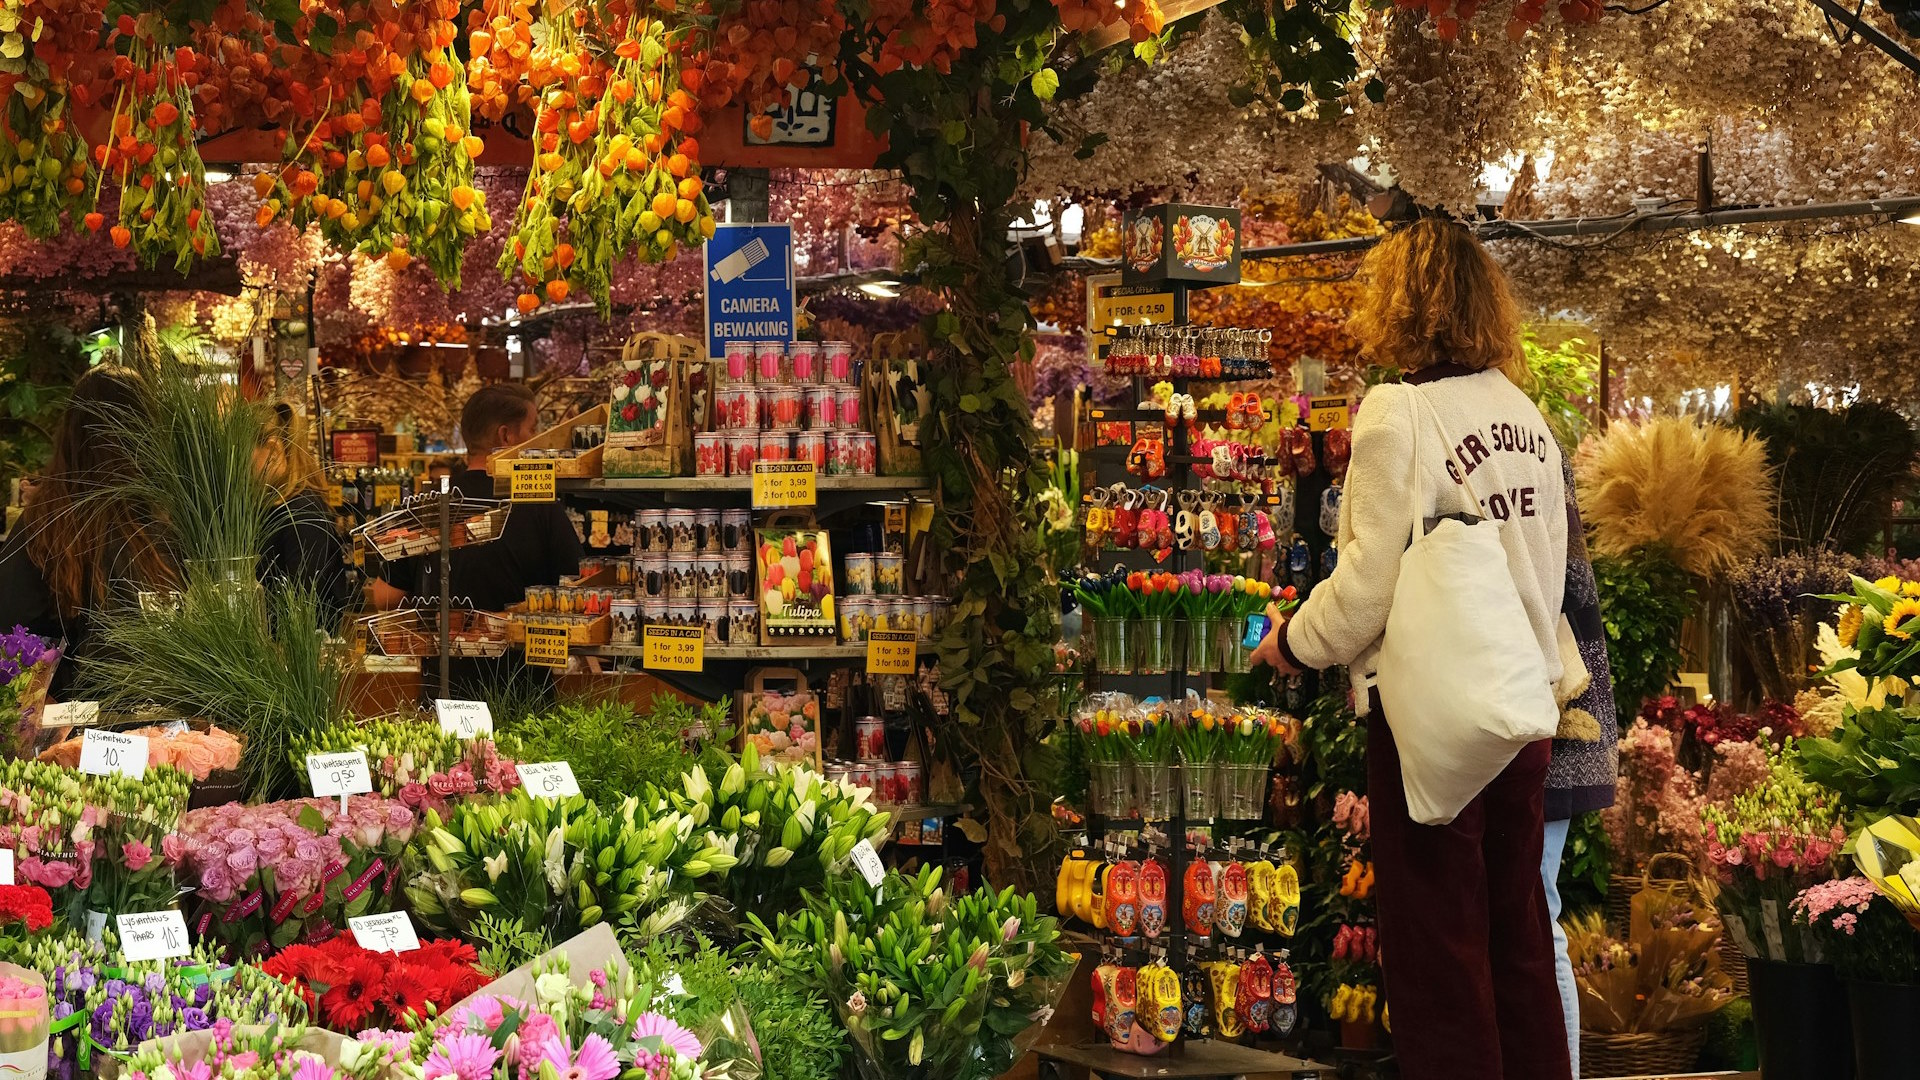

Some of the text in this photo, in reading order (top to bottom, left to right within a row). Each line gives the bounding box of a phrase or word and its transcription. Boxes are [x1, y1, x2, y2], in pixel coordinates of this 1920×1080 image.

[1191, 217, 1207, 225] MADE
[721, 298, 780, 313] CAMERA
[1107, 304, 1165, 317] 1 FOR: € 2,50
[714, 321, 788, 338] BEWAKING
[1445, 423, 1546, 485] GIR SQUAD
[797, 464, 812, 472] CAN
[789, 479, 807, 487] 3,99
[786, 490, 807, 499] 10,00
[1480, 487, 1536, 522] OVE
[782, 603, 821, 620] Tulipa
[678, 644, 695, 652] 3,99
[897, 648, 910, 656] 3,99
[660, 655, 671, 663] for
[674, 656, 695, 664] 10,00
[894, 660, 910, 668] 10,00
[311, 758, 321, 770] 10
[353, 920, 363, 931] 10
